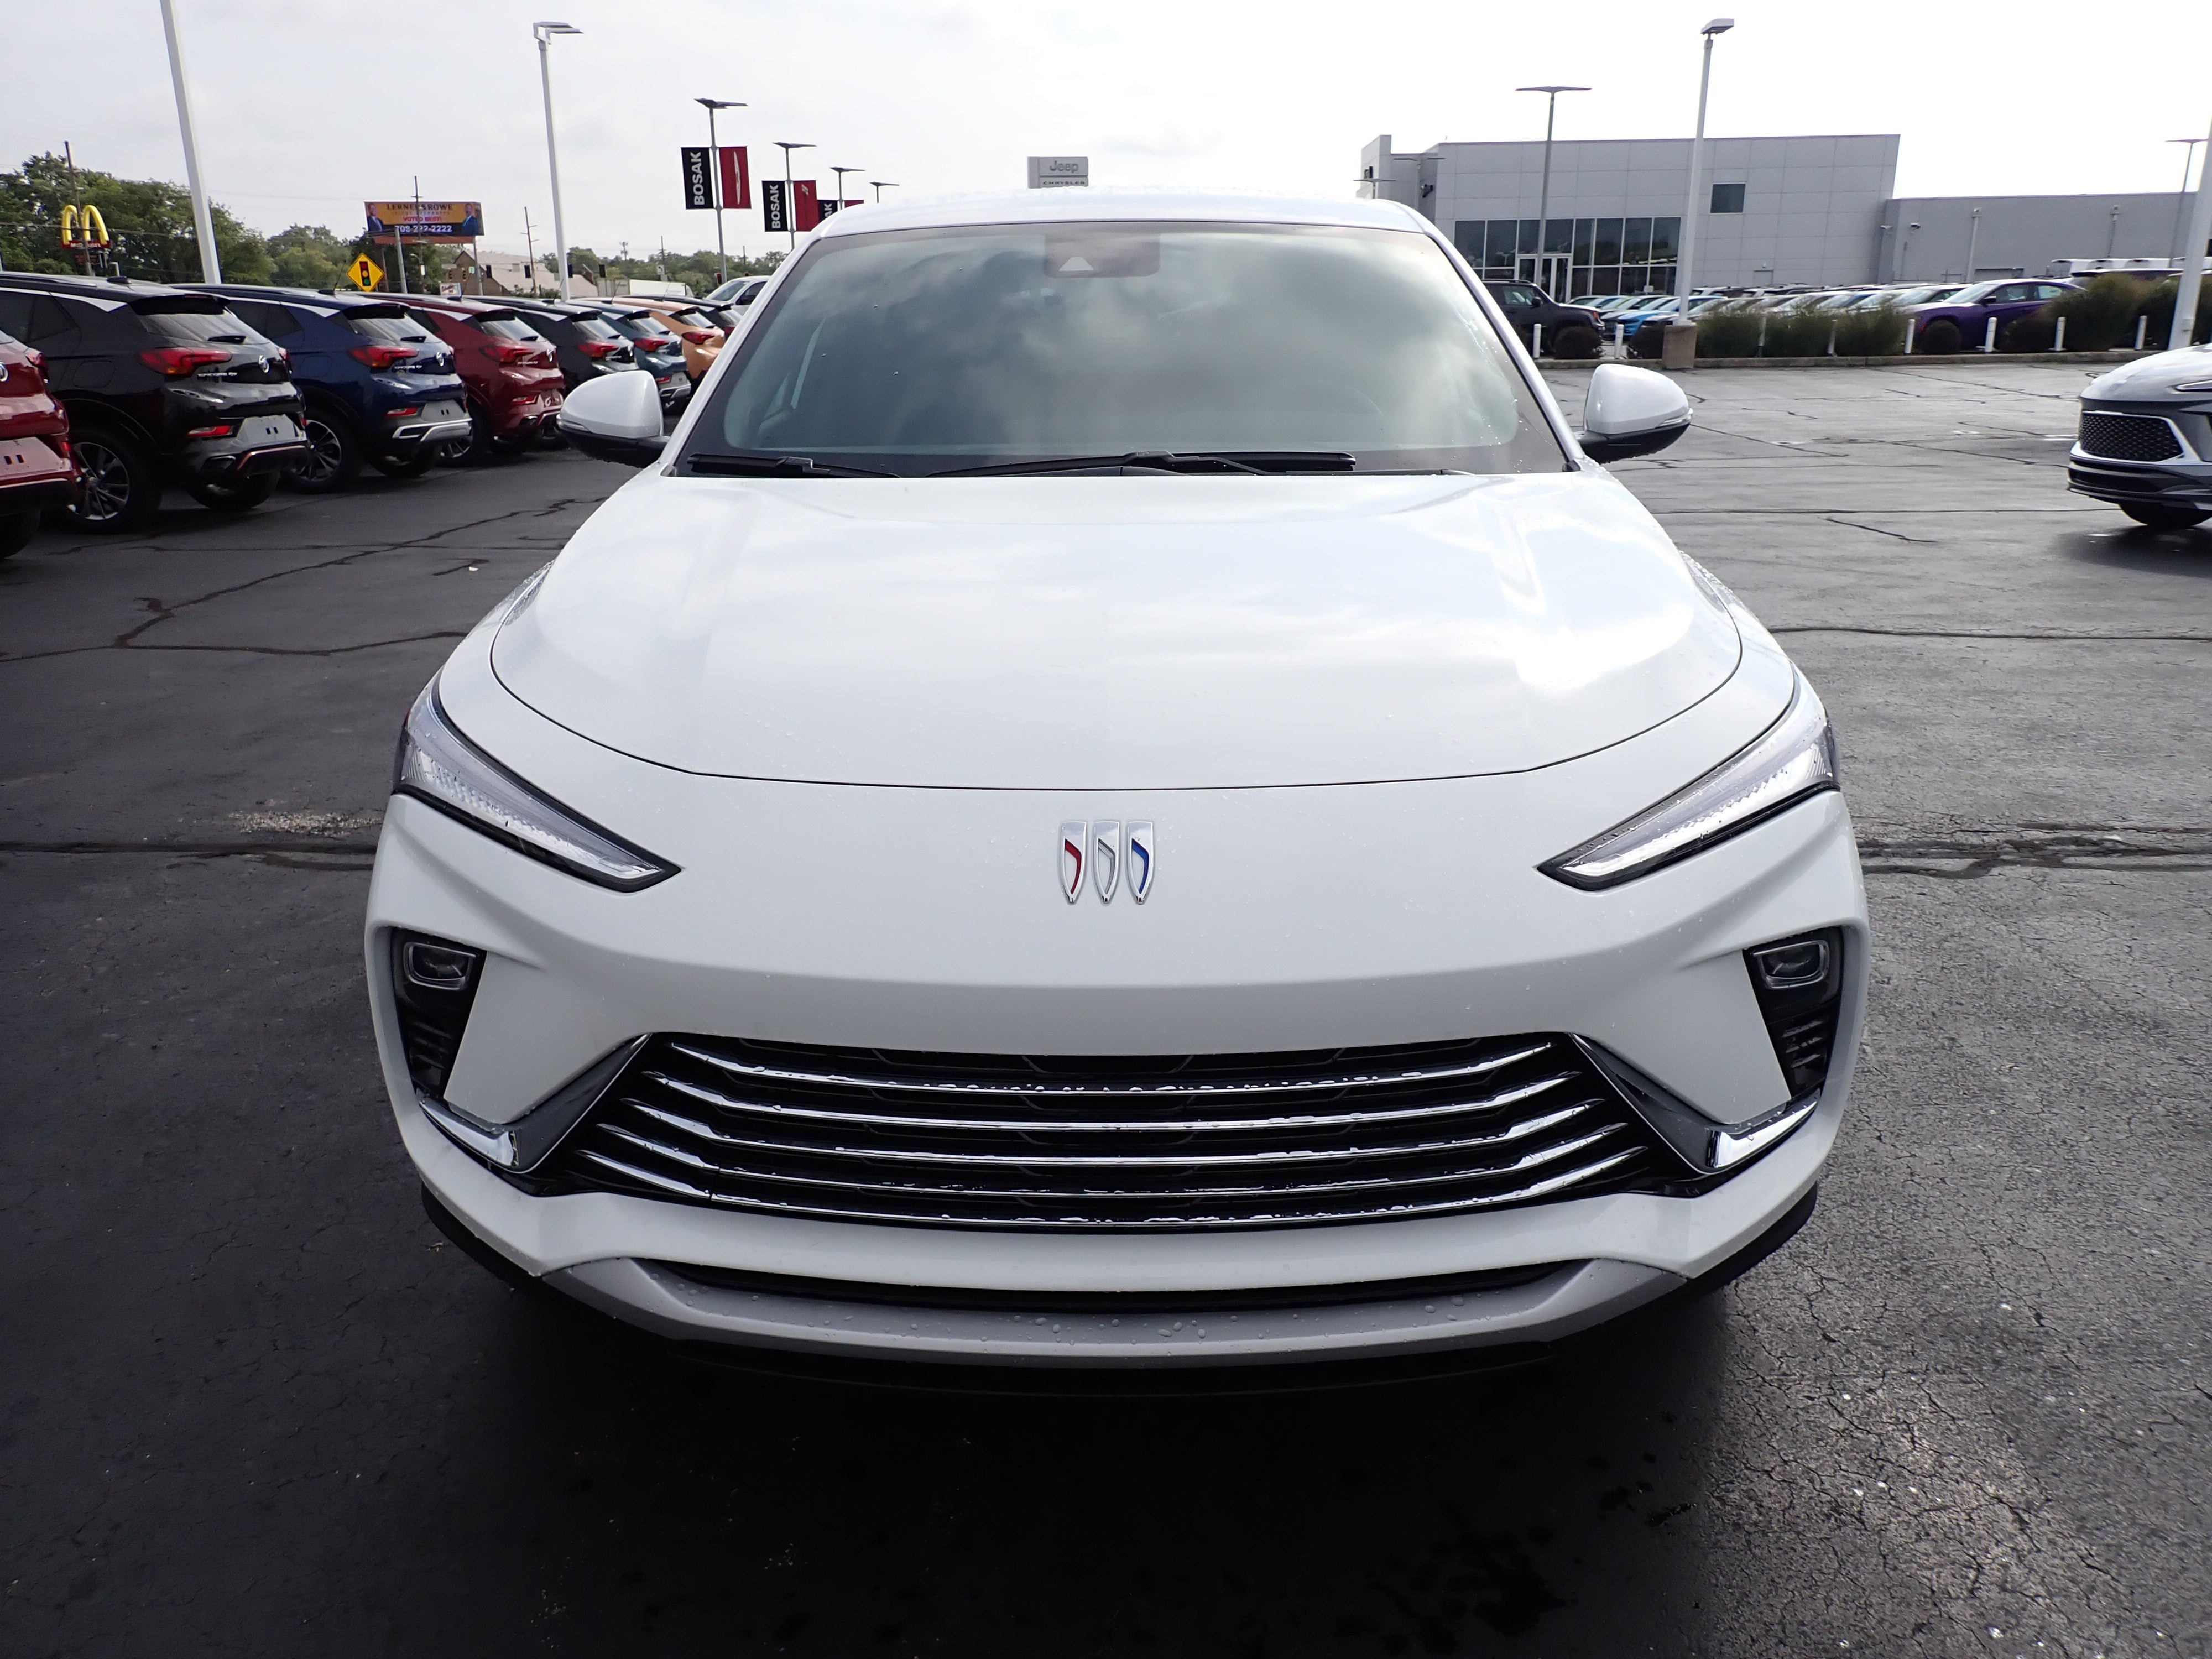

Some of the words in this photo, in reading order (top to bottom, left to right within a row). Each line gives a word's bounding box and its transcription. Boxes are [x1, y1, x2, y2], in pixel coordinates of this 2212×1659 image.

[690, 151, 705, 205] BOSAK
[1049, 160, 1078, 173] Jeep
[769, 184, 781, 229] BOSAK
